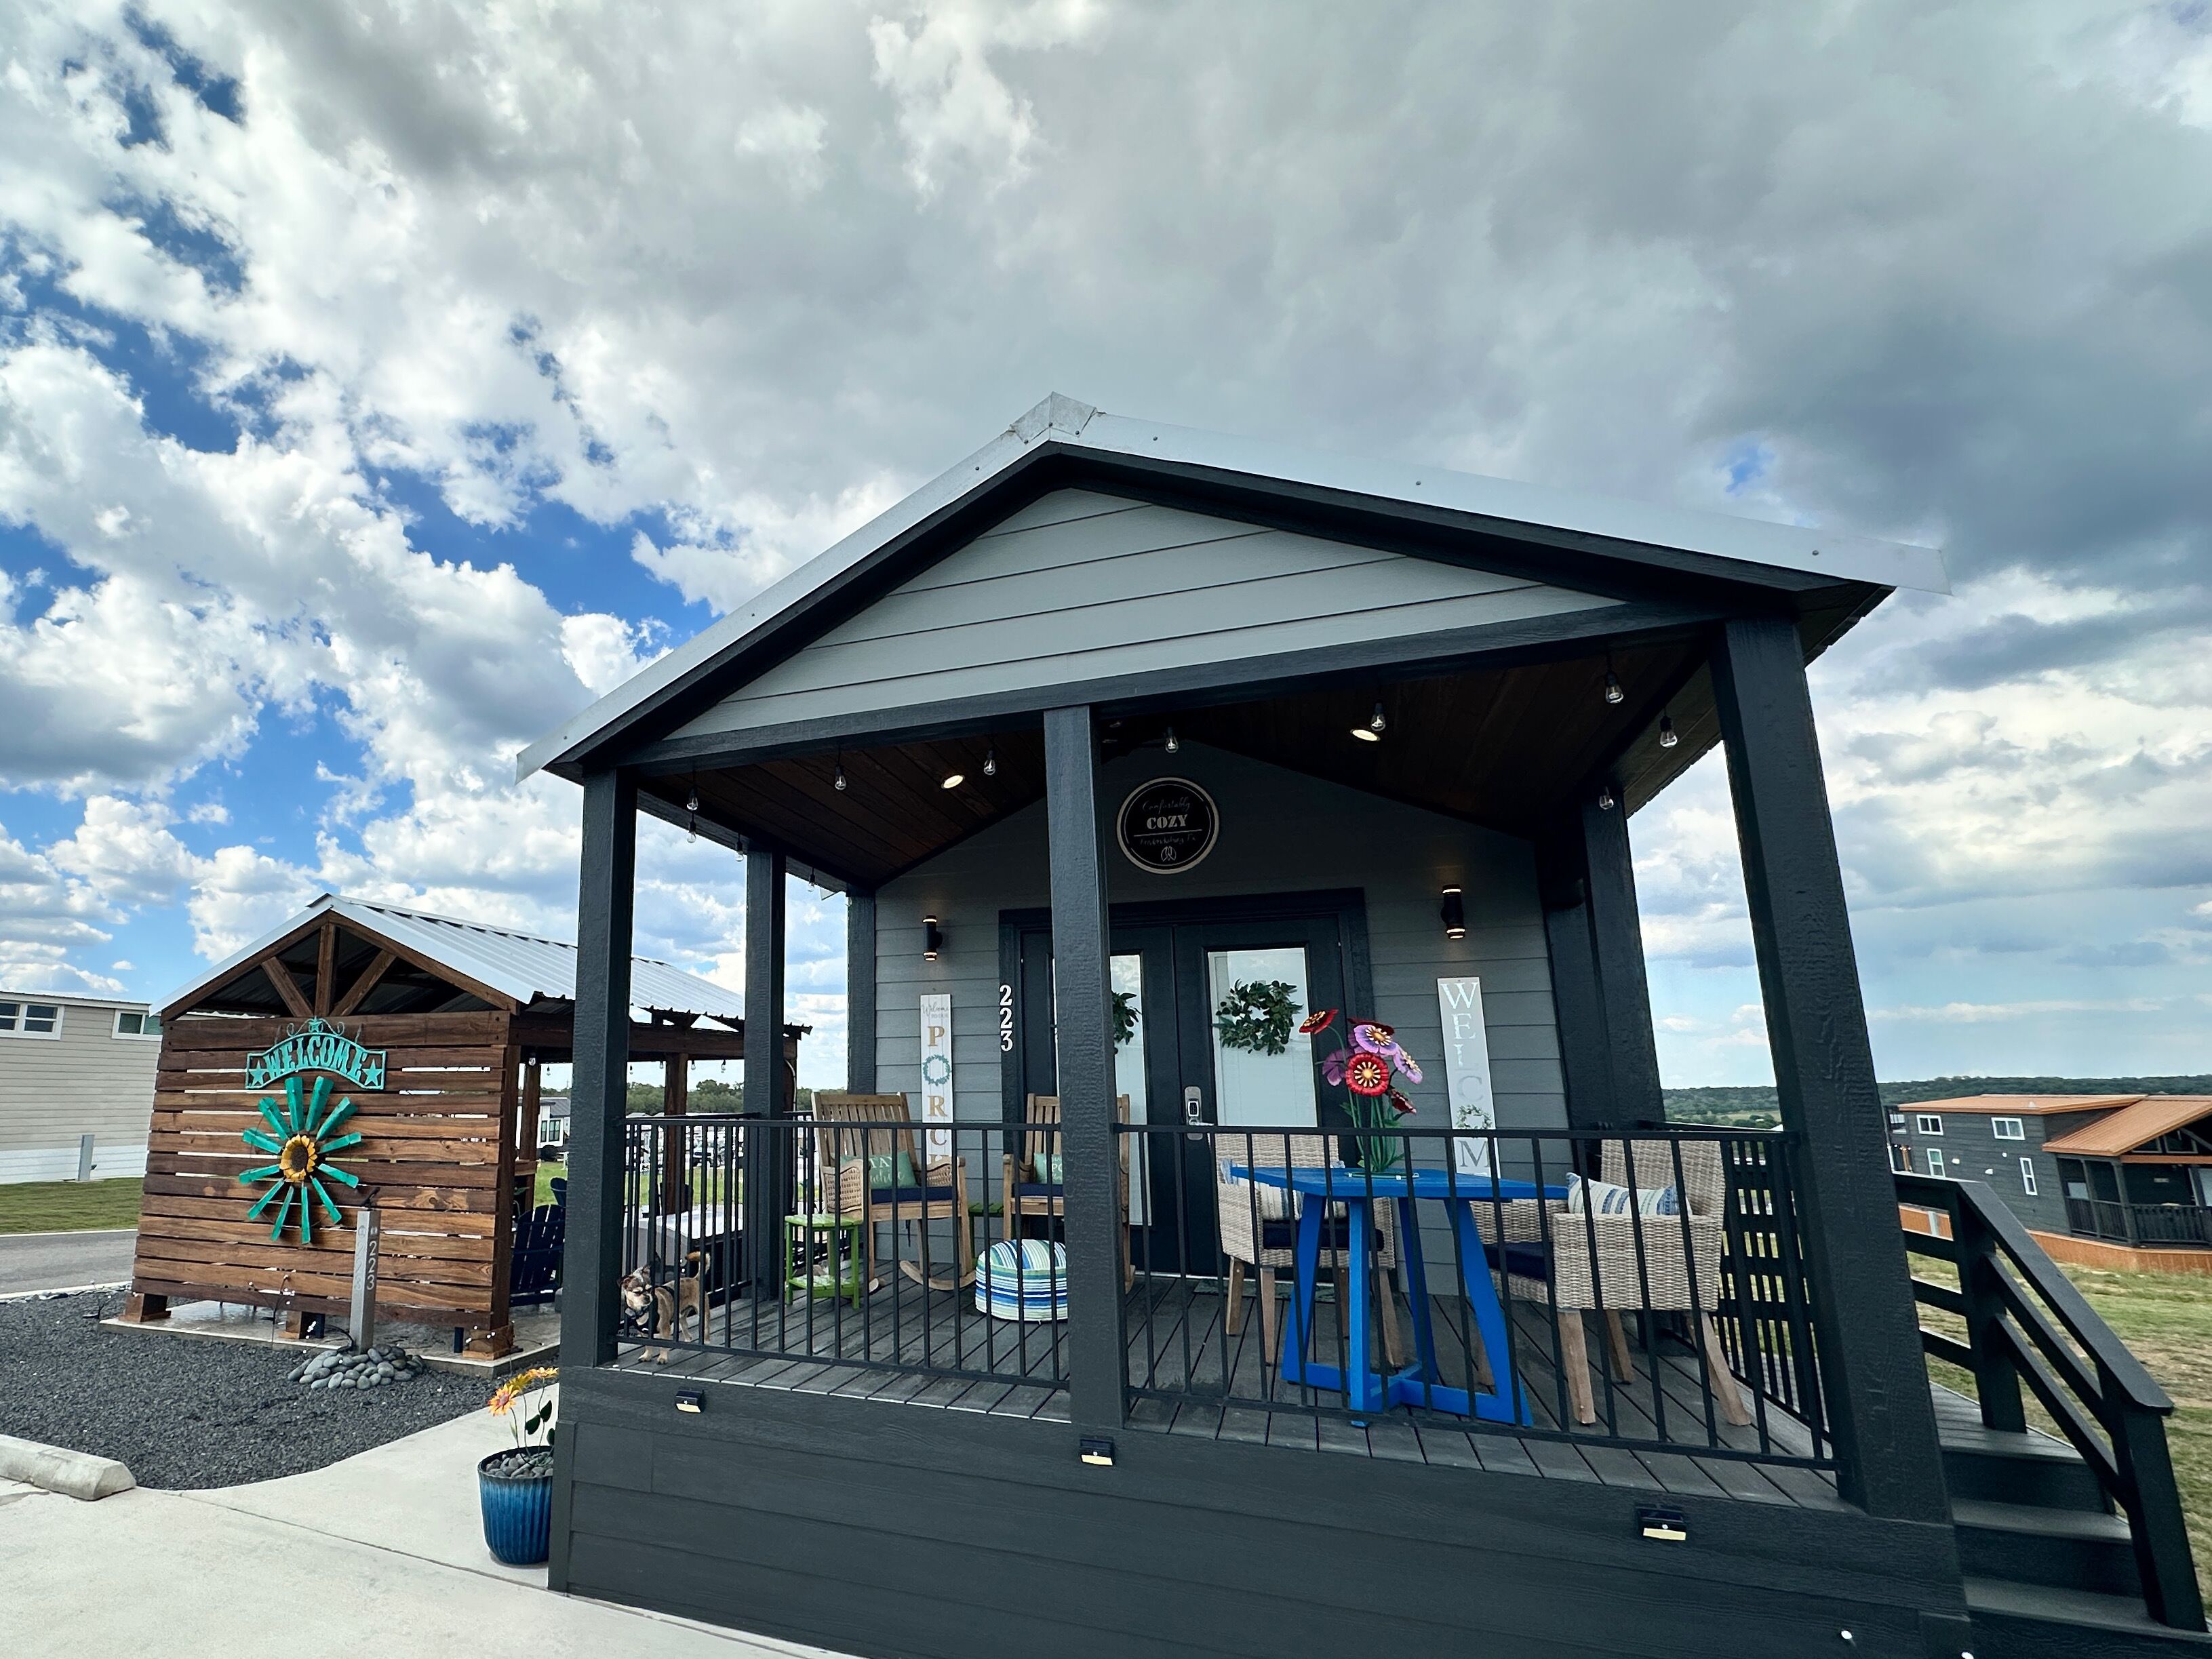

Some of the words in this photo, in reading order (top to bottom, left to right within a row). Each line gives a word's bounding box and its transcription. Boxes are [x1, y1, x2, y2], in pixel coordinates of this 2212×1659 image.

[1147, 814, 1188, 830] COZY
[1000, 984, 1014, 1052] 223
[263, 1035, 368, 1081] WELCOME
[367, 1240, 377, 1290] 223
